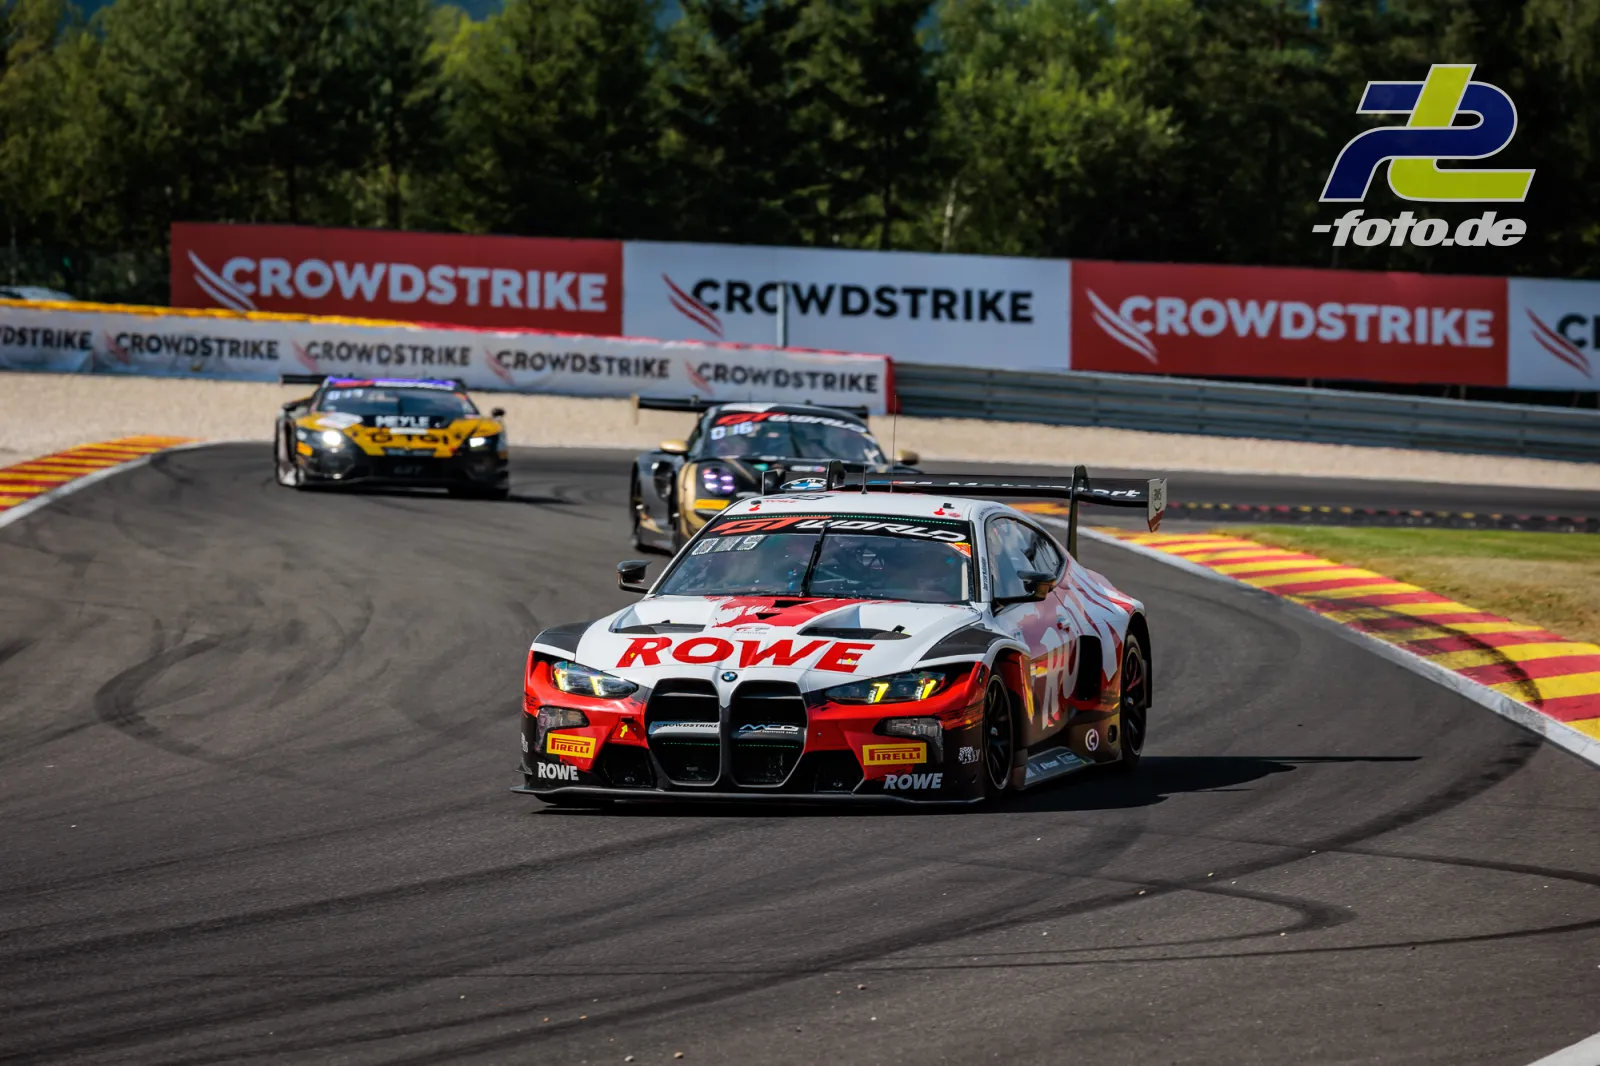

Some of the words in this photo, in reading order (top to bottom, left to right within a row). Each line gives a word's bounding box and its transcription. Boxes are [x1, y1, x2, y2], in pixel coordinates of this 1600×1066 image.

[222, 256, 607, 313] CROWDSTRIKE
[692, 278, 1034, 325] CROWDSTRIKE
[1119, 296, 1495, 348] CROWDSTRIKE
[0, 326, 93, 350] DSTRIKE
[115, 332, 280, 360] CROWDSTRIKE
[306, 340, 472, 367] CROWDSTRIKE
[496, 350, 671, 379] CROWDSTRIKE
[697, 362, 879, 393] CROWDSTRIKE
[375, 416, 430, 427] MEYLE
[709, 516, 833, 535] GT
[795, 519, 967, 543] WORLD
[616, 636, 876, 674] ROWE
[551, 737, 590, 754] PIRELLI
[868, 746, 921, 762] PIRELLI
[537, 761, 580, 781] ROWE
[883, 772, 944, 790] ROWE
